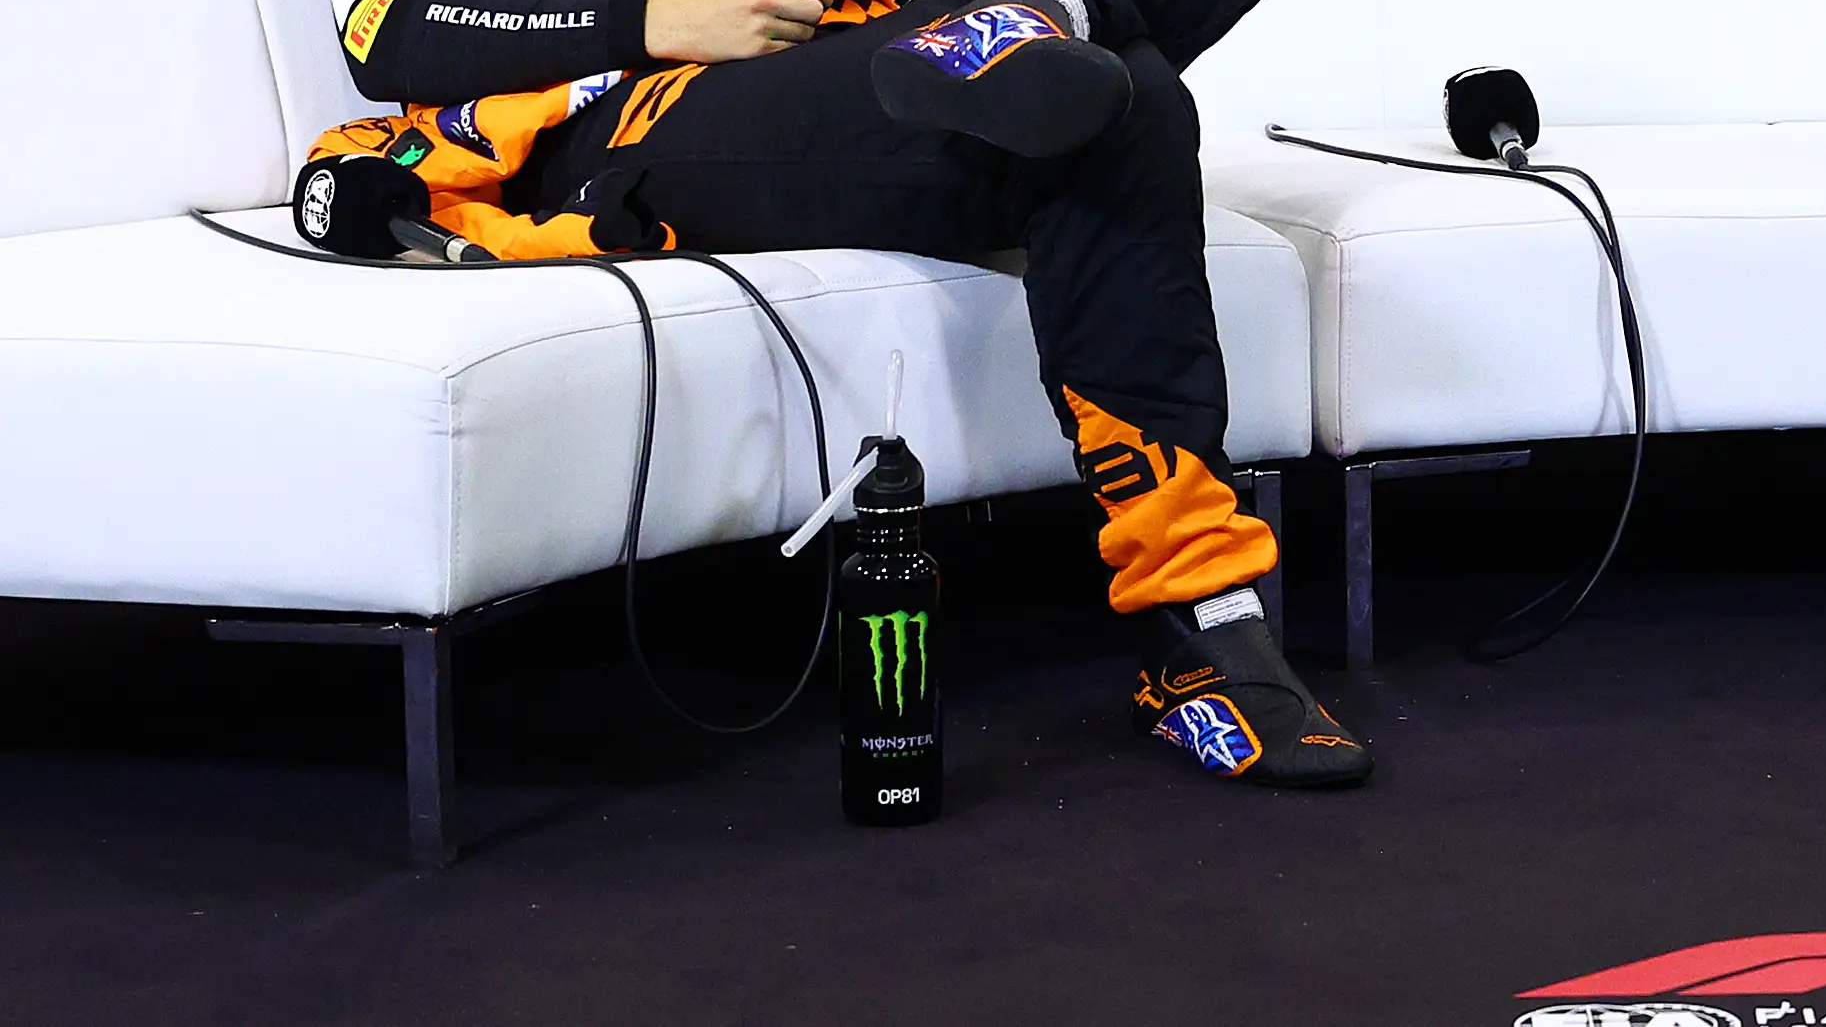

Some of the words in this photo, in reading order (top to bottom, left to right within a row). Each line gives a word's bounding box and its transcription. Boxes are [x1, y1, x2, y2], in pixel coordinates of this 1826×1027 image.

[425, 3, 524, 31] RICHARD
[526, 10, 596, 30] MILLE
[862, 734, 933, 751] MONSTER
[878, 787, 920, 805] OP81
